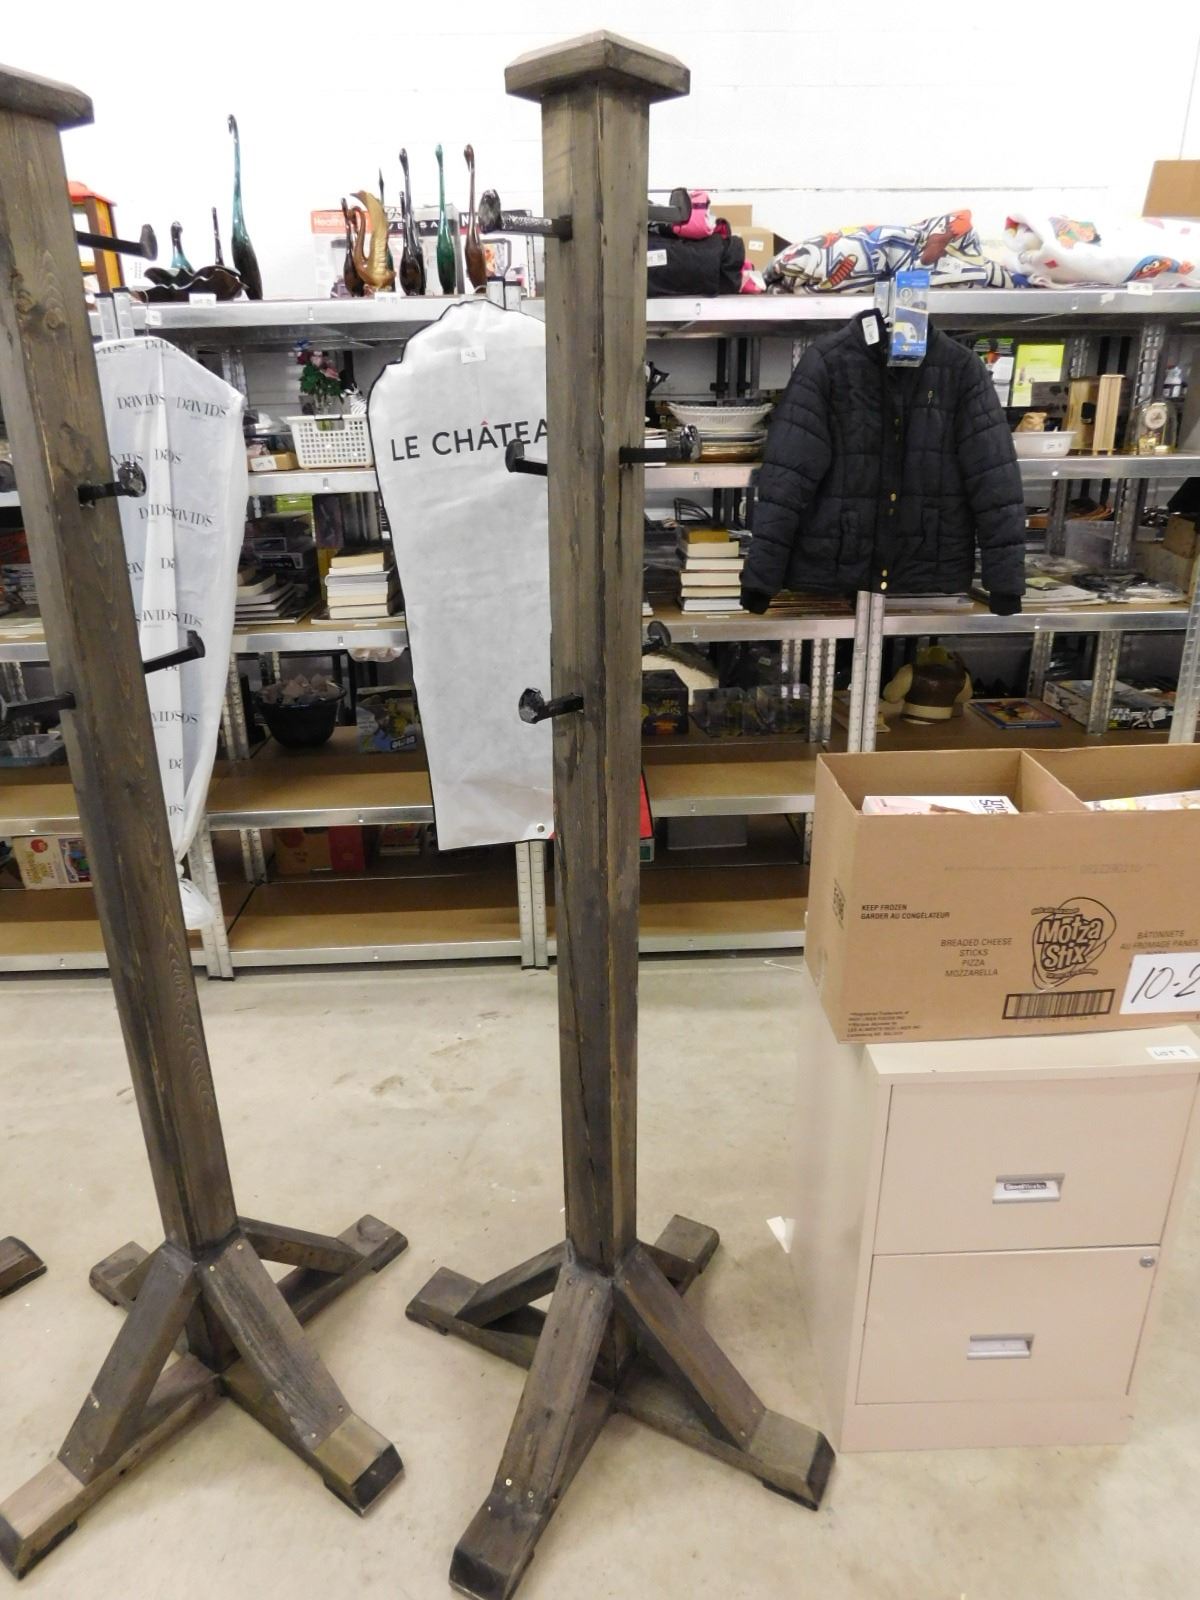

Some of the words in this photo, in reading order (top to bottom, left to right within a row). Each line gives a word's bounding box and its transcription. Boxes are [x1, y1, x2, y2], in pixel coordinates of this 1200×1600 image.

[391, 436, 420, 461] LE
[432, 418, 548, 456] CHÂTEA
[941, 939, 979, 947] BREADED
[981, 938, 1013, 946] CHEESE
[959, 949, 989, 957] STICKS
[1041, 943, 1087, 971] Stix
[962, 959, 985, 967] PIZZA
[945, 969, 998, 977] MOZZARELLA
